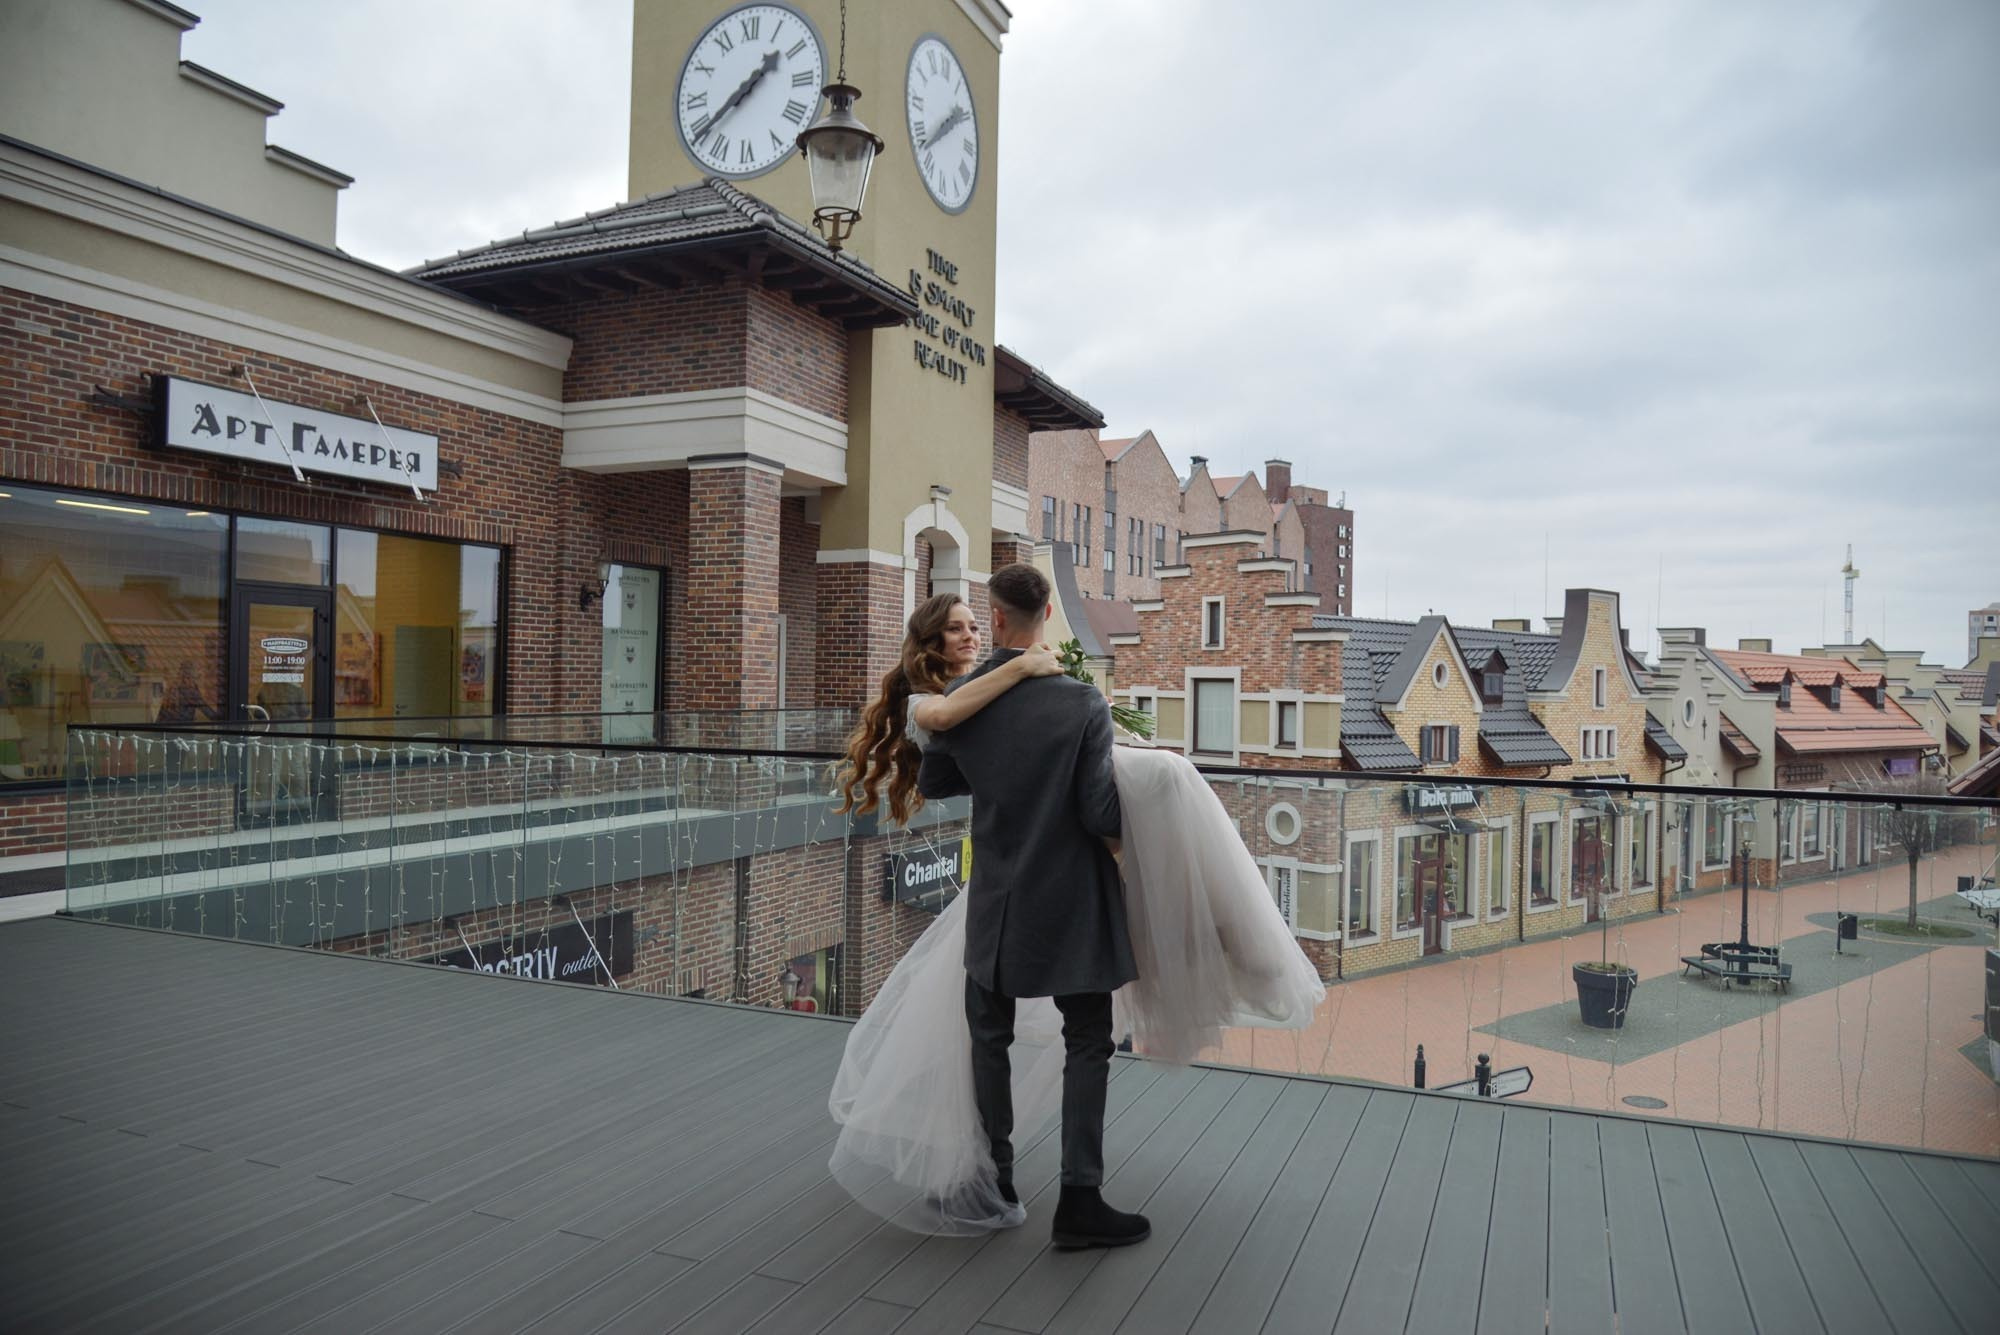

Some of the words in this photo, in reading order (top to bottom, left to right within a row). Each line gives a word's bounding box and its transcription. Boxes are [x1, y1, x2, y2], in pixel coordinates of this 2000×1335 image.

[926, 247, 959, 285] TIME
[908, 268, 922, 297] IS
[924, 281, 975, 328] SMART
[914, 339, 968, 385] REALITY
[943, 325, 960, 349] OF
[960, 335, 986, 367] OUR
[1337, 524, 1346, 617] HOTEL
[264, 656, 282, 665] 11:00
[287, 657, 305, 665] 19:00
[905, 852, 958, 886] Chantal
